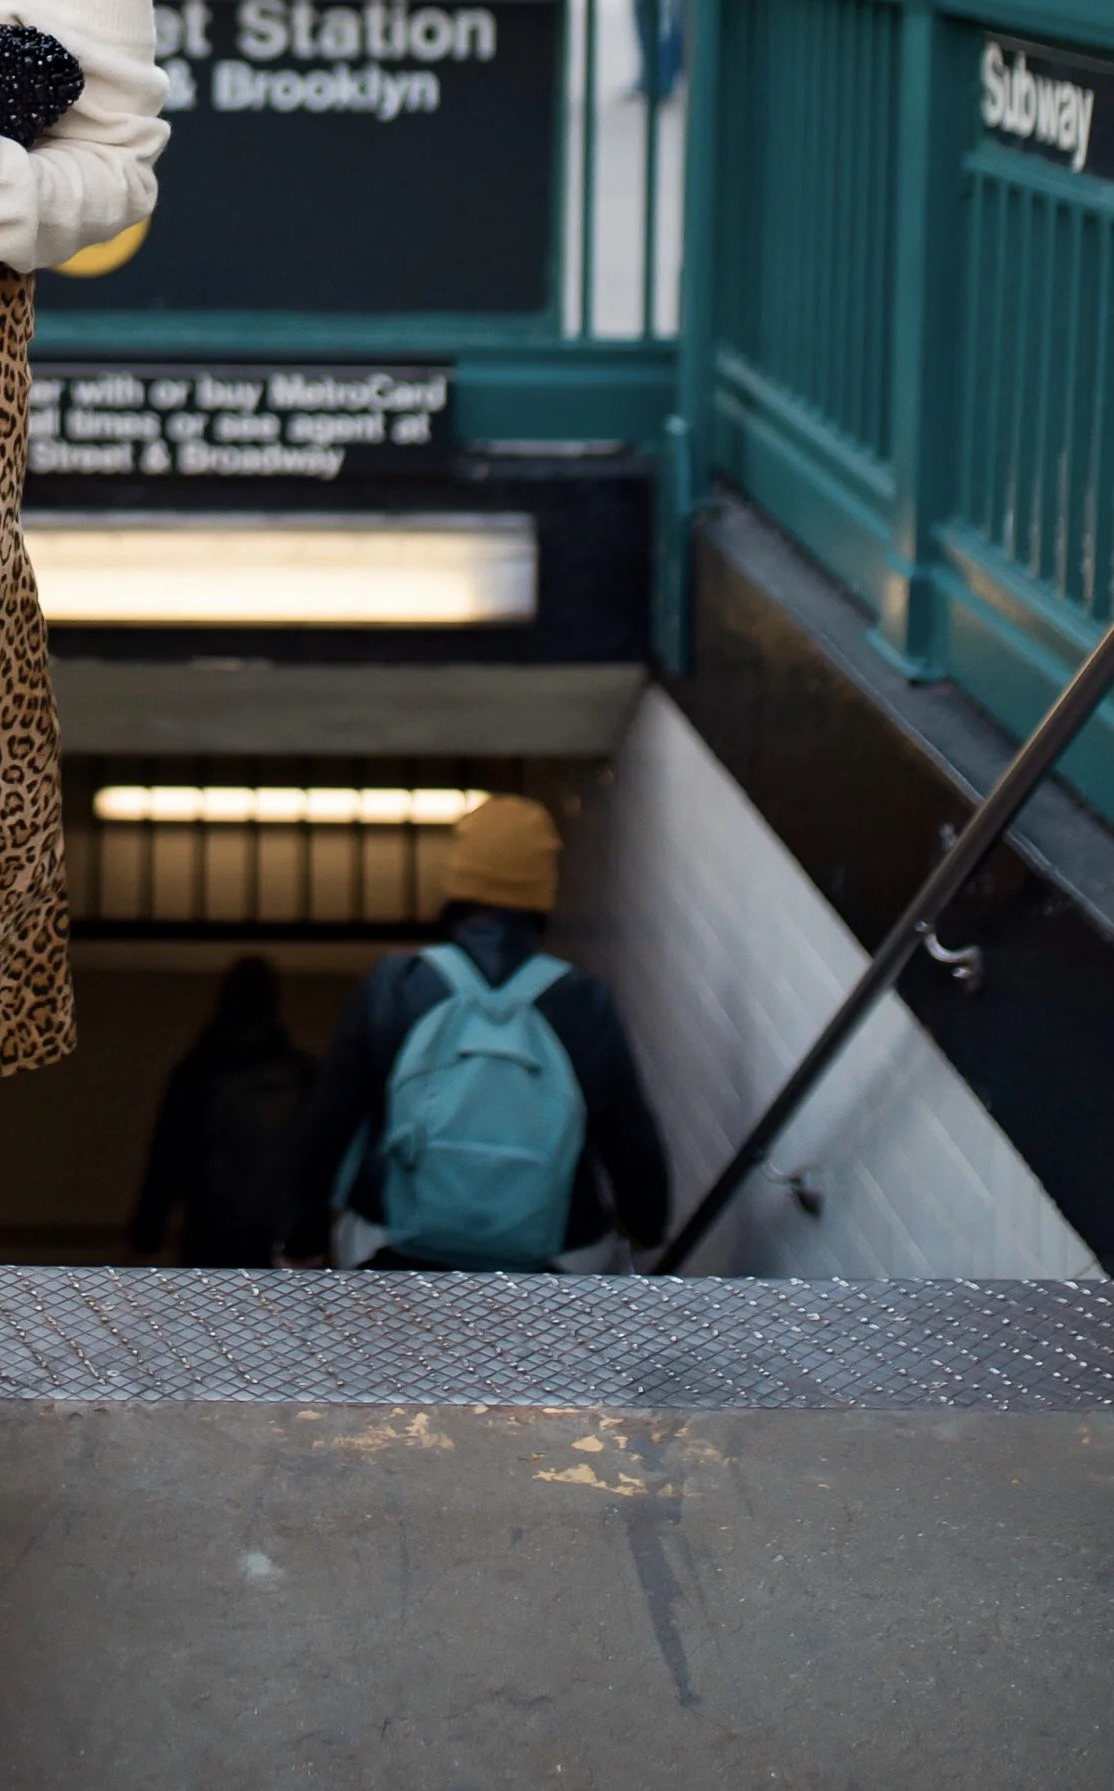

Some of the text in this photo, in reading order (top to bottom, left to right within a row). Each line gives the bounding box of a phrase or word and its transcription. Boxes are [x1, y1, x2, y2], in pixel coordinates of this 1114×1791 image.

[213, 59, 441, 123] Brooklyn
[981, 41, 1094, 173] Subway
[70, 371, 146, 408] with
[148, 379, 191, 409] or
[196, 372, 263, 417] buy
[268, 371, 448, 411] MetroCard
[65, 408, 162, 442] times
[164, 411, 209, 442] or
[212, 412, 282, 443] see
[287, 409, 386, 449] agent
[390, 410, 431, 445] at
[30, 439, 346, 481] Street & Broadway
